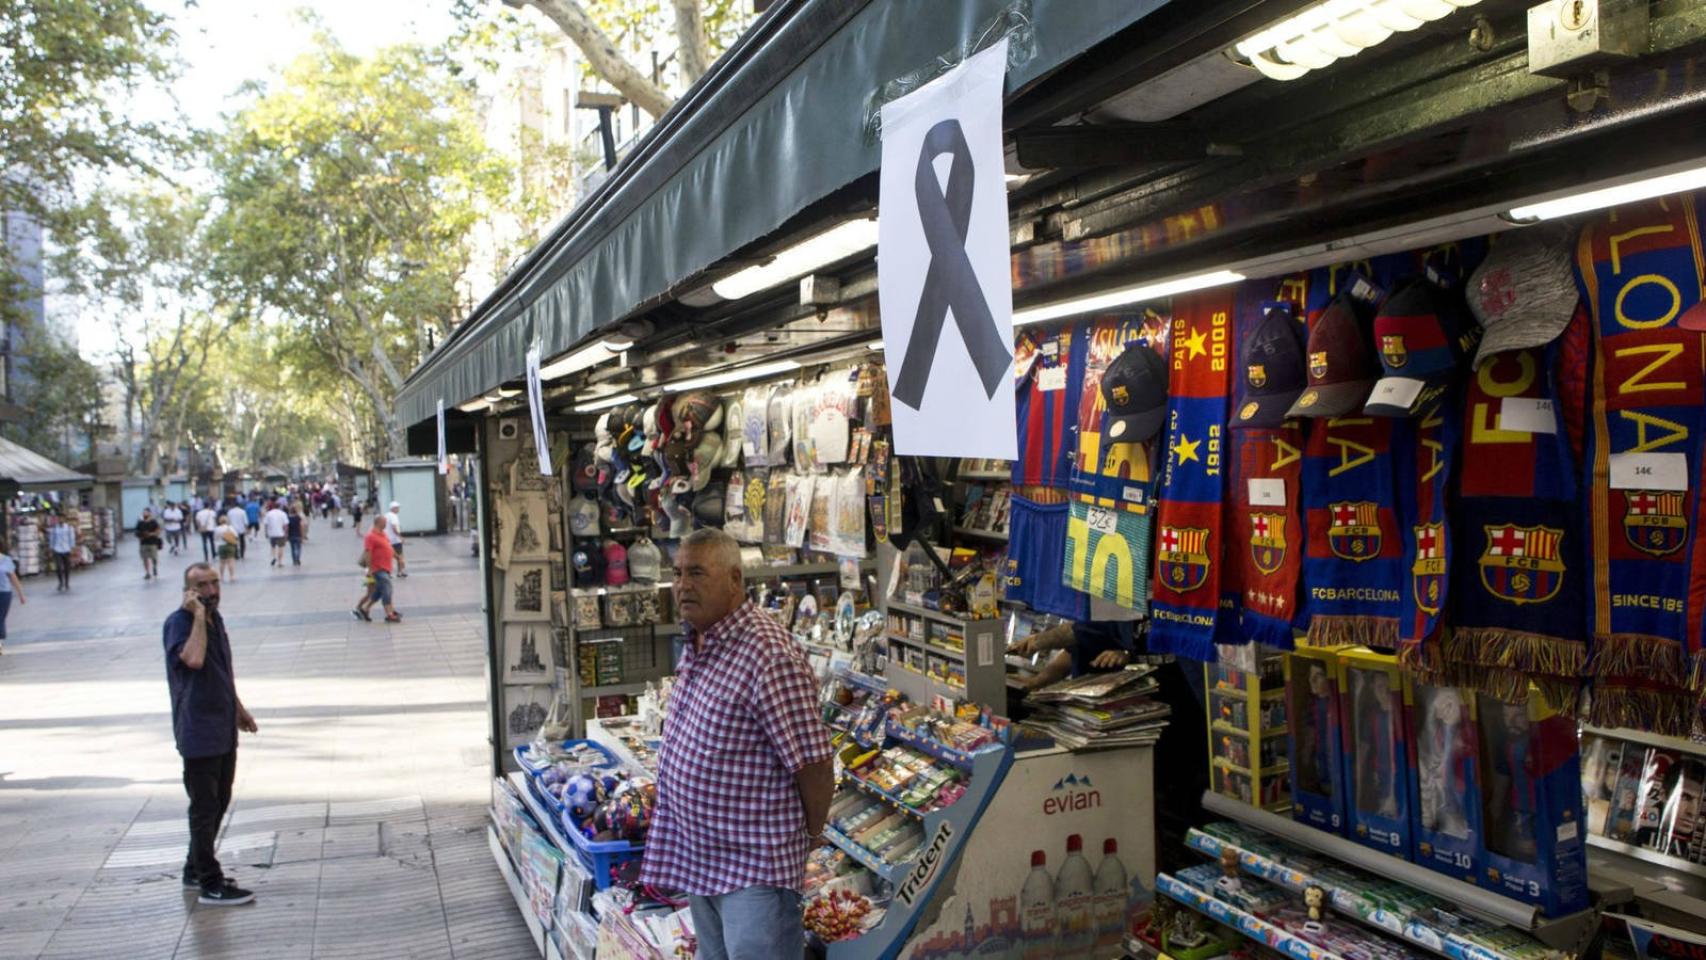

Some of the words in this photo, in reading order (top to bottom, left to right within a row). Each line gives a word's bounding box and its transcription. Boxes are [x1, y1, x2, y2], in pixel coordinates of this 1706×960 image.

[1174, 319, 1185, 370] PARIS
[1211, 312, 1226, 371] 2006
[1207, 424, 1220, 476] 1992
[1643, 516, 1669, 525] FCB
[1344, 526, 1369, 535] FCB
[1168, 552, 1189, 562] FCB
[1505, 557, 1539, 568] FCB
[1612, 594, 1660, 609] SINCE
[1043, 789, 1101, 816] evian
[1331, 814, 1340, 828] 9
[1389, 832, 1400, 847] 8
[897, 821, 952, 906] Trident
[1455, 852, 1471, 869] 10
[1528, 880, 1540, 897] 3
